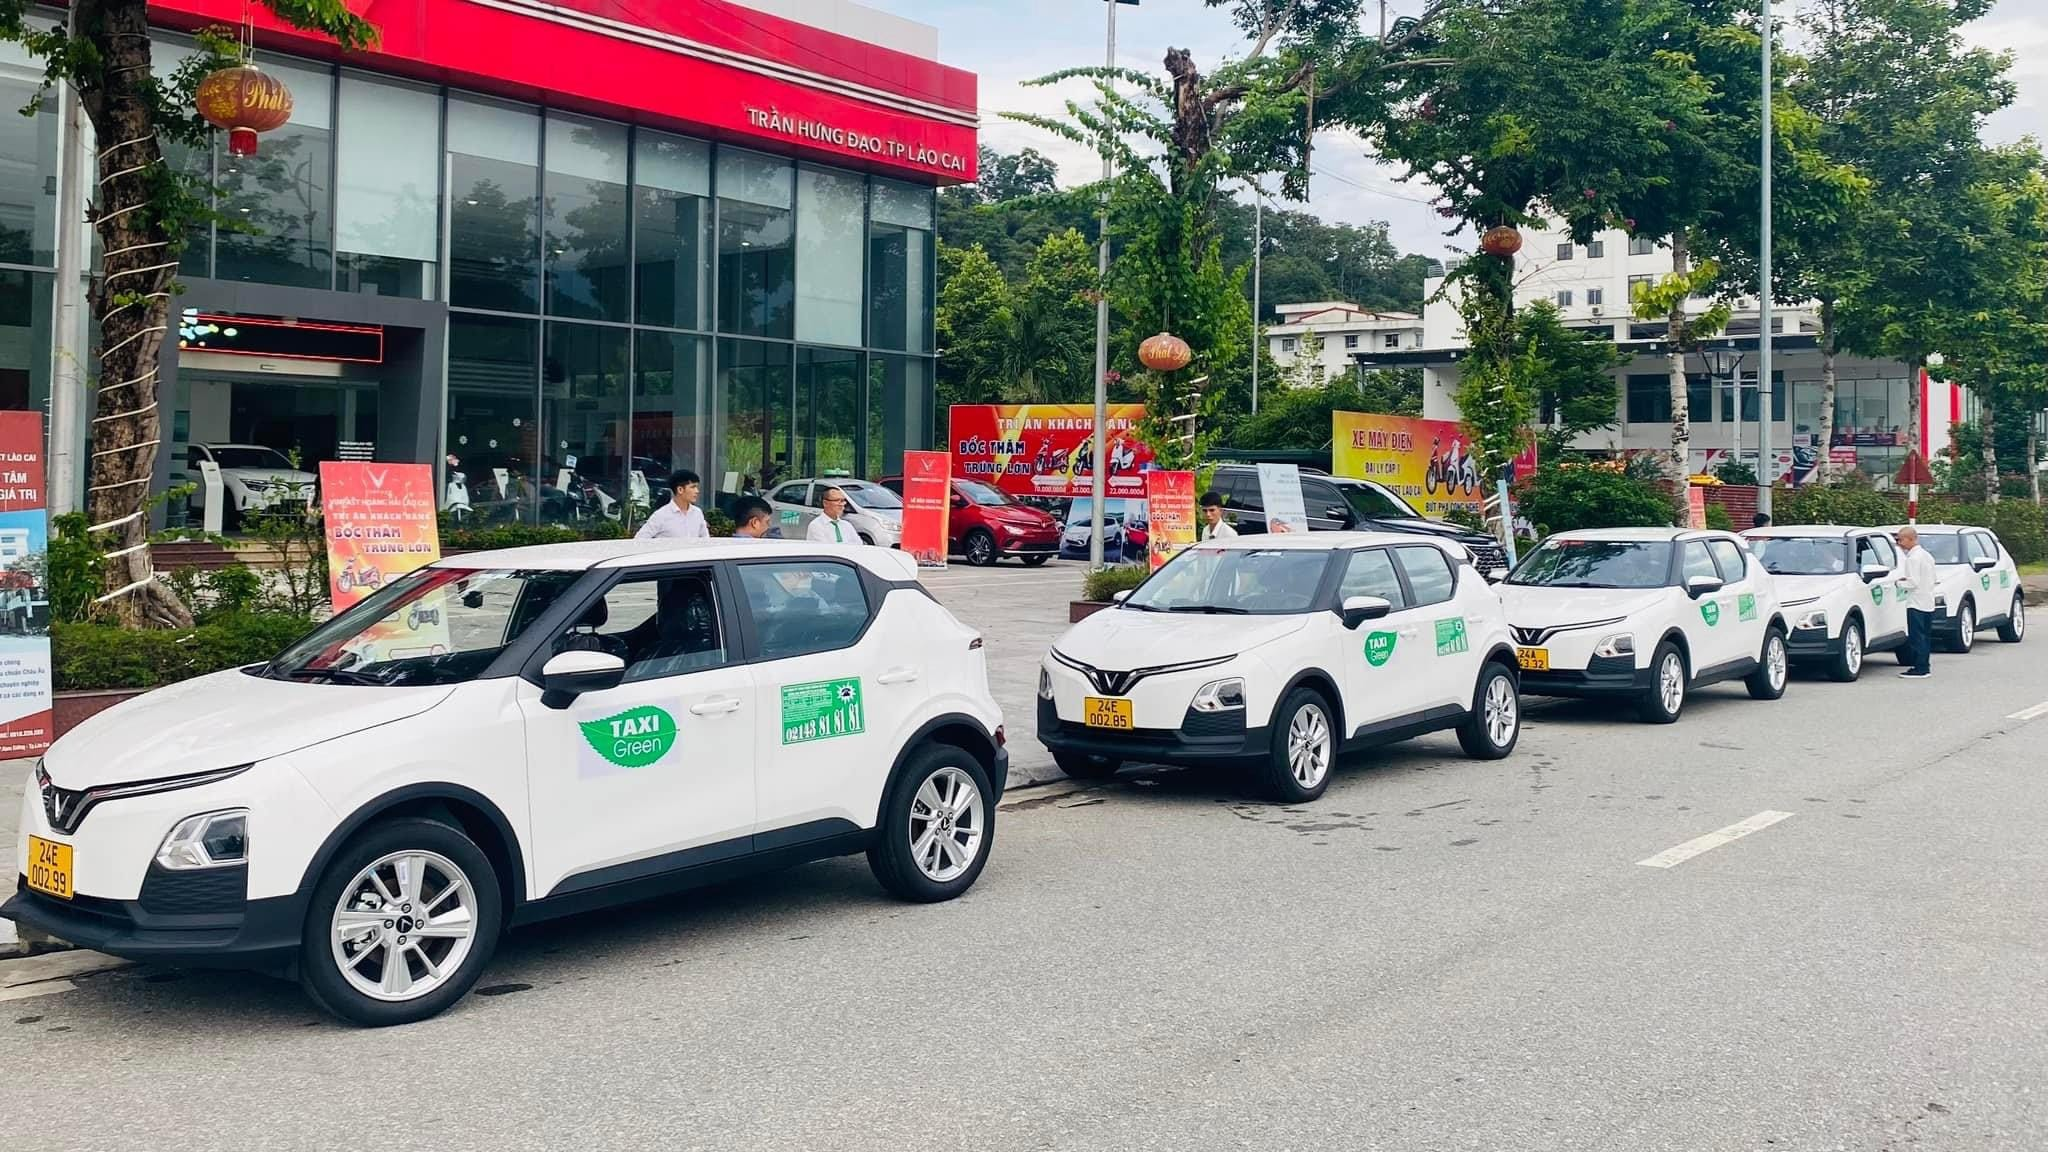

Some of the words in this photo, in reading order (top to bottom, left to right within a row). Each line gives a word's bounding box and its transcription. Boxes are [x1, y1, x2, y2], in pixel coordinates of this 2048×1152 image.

[749, 105, 794, 134] TRẦN
[799, 121, 844, 145] HƯNG
[908, 143, 938, 166] LÀO
[941, 152, 966, 172] CAI
[960, 436, 986, 455] BỐC
[1352, 430, 1365, 447] XE
[23, 454, 37, 462] CAI
[2, 470, 27, 484] TÂM
[18, 489, 37, 503] TRỊ
[1368, 636, 1388, 650] TAXI
[1519, 649, 1537, 658] 24A
[1097, 700, 1118, 713] 24E
[609, 714, 660, 738] TAXI
[1090, 713, 1127, 727] 002.85
[613, 737, 662, 758] Green
[39, 841, 58, 867] 24E
[32, 863, 66, 894] 002.99
